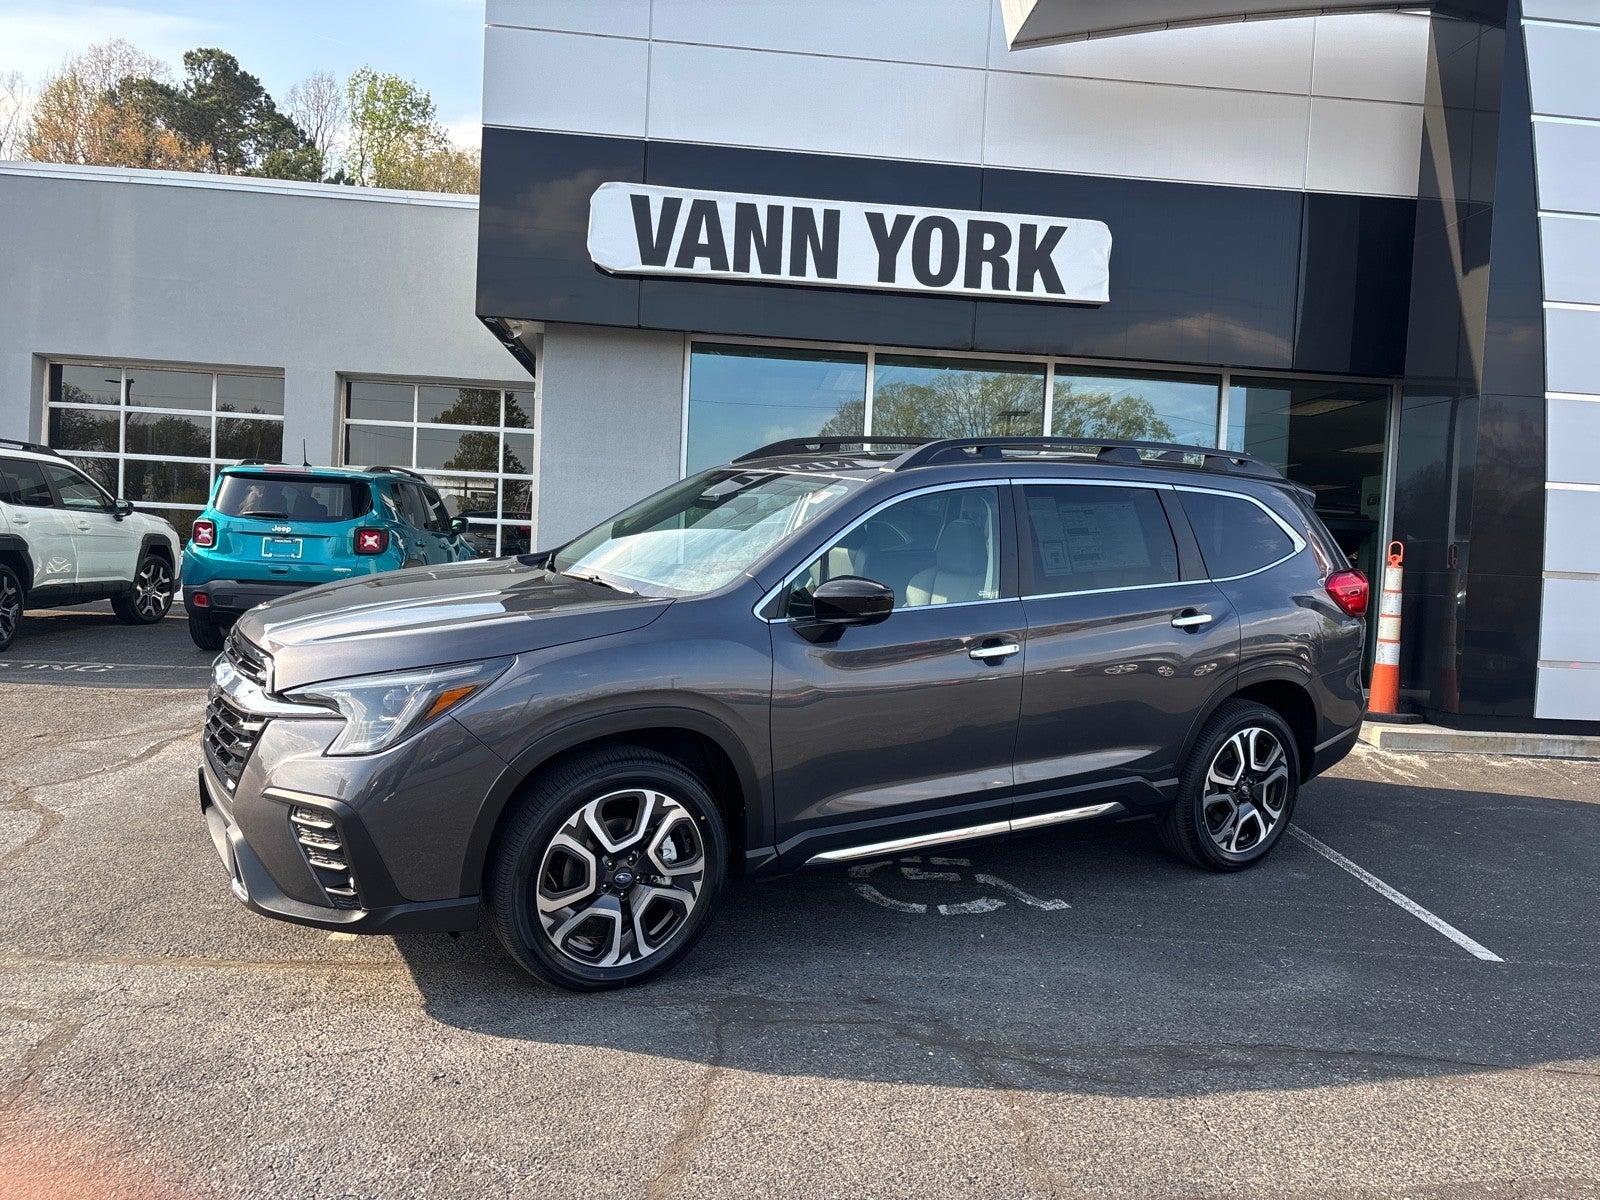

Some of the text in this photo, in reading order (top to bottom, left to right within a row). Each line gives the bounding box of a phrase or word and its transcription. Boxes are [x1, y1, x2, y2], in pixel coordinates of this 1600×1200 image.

[629, 193, 1069, 295] VANN YORK
[271, 524, 292, 534] Jeep
